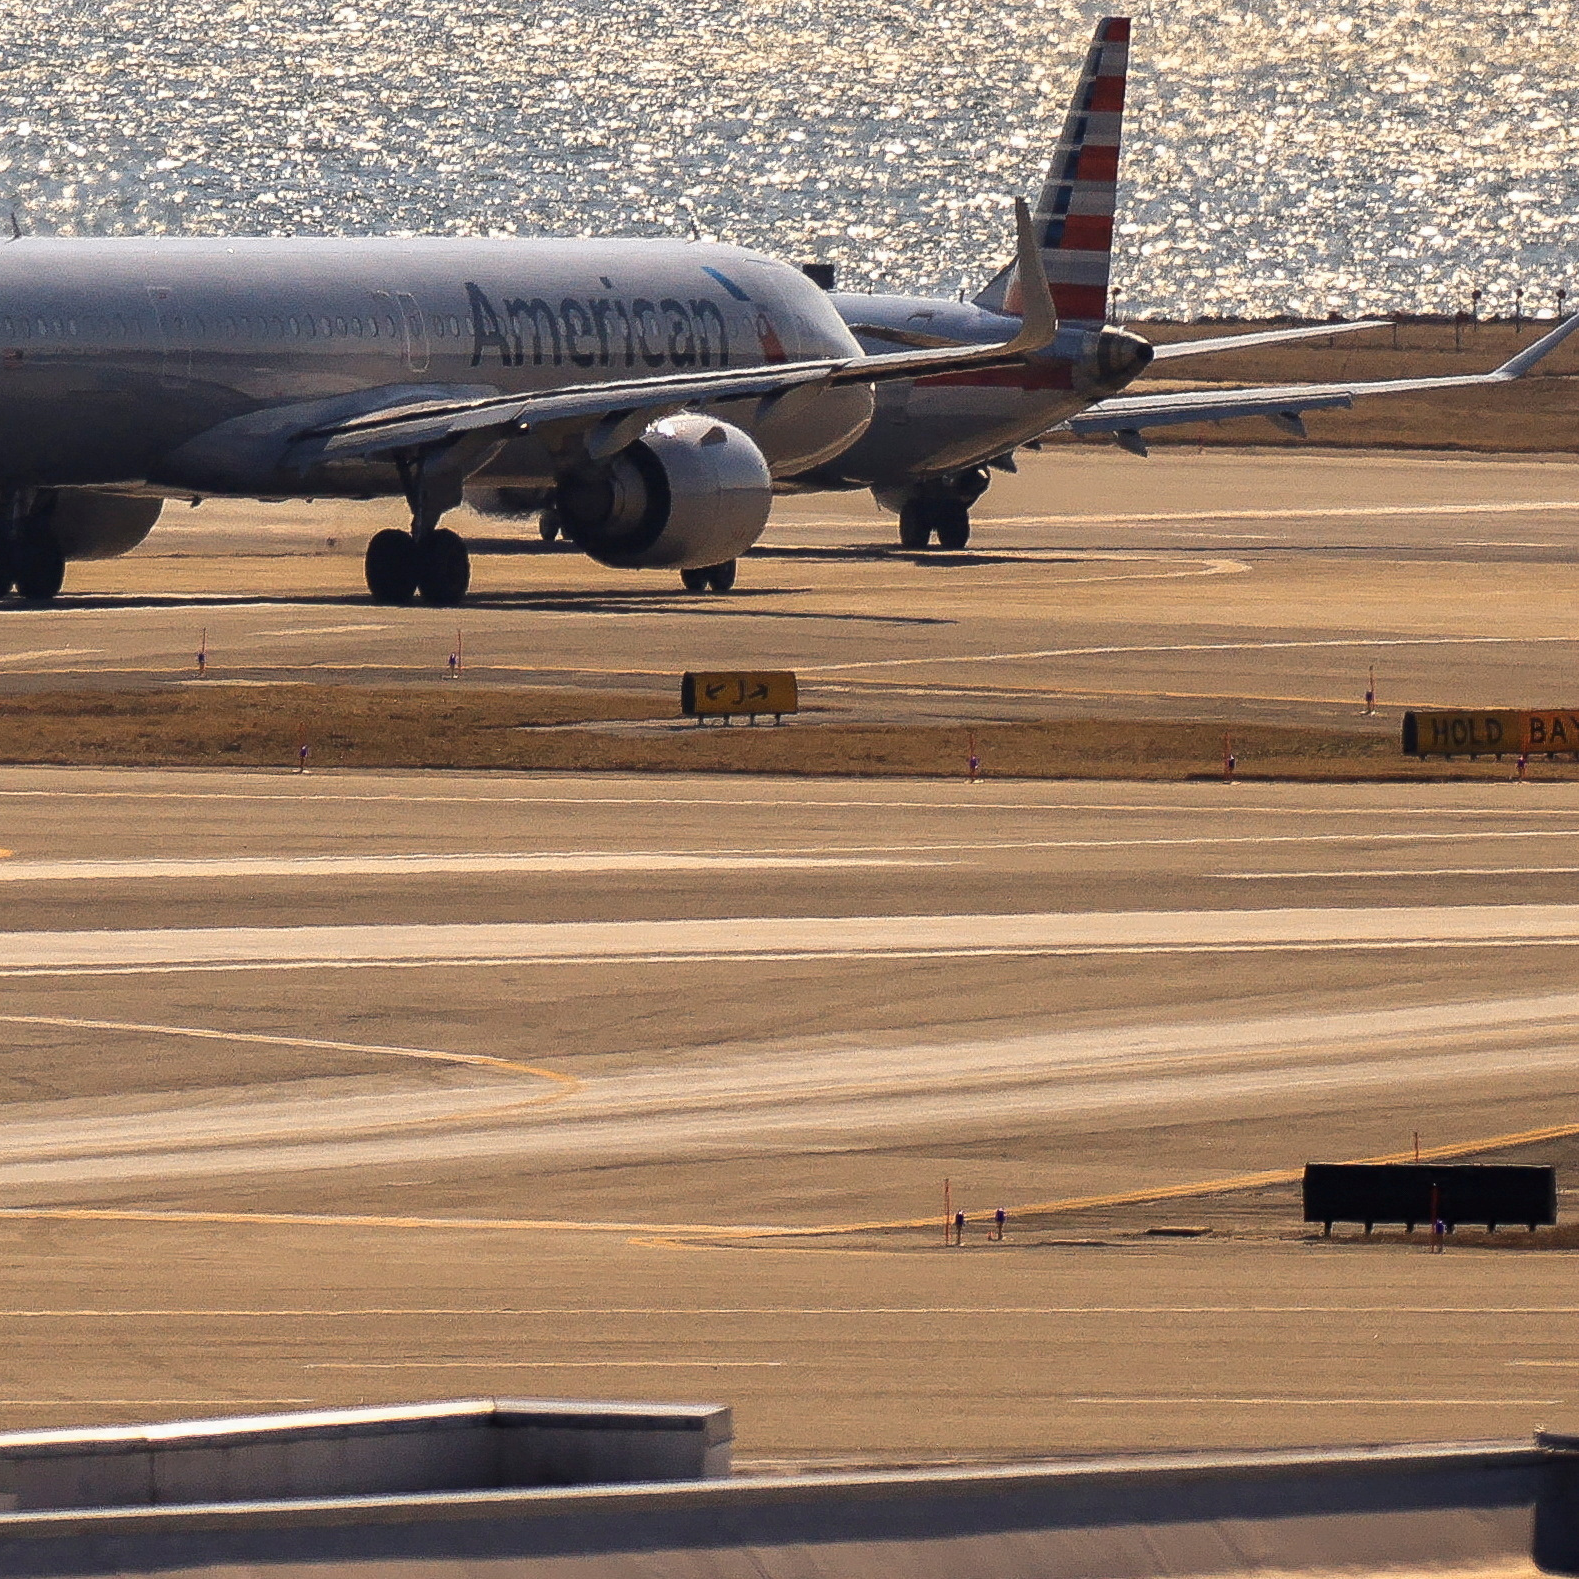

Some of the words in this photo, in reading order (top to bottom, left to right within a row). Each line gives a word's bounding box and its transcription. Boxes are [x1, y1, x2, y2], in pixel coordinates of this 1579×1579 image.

[465, 276, 729, 367] American
[731, 679, 745, 705] J
[1432, 718, 1504, 745] HOLD
